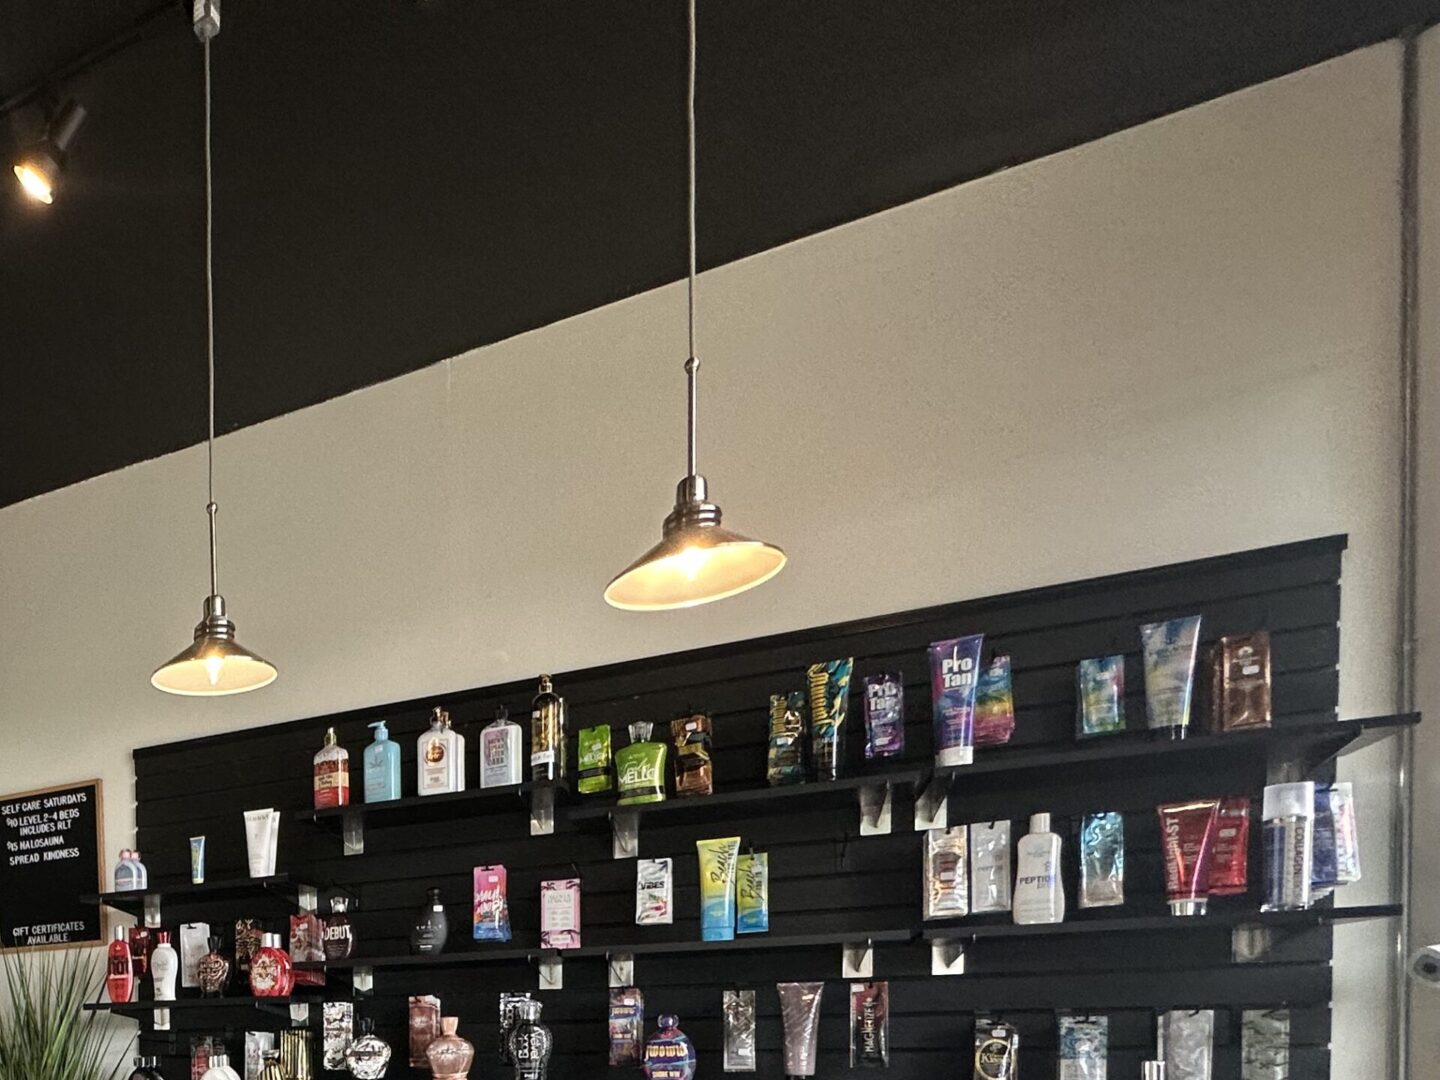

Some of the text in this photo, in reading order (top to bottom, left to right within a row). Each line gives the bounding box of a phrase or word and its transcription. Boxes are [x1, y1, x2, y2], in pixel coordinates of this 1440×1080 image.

[942, 657, 973, 674] Pro
[942, 672, 973, 688] Tan
[868, 682, 897, 698] Pro
[2, 793, 87, 815] SELF CARE SATURDAYS
[20, 815, 42, 826] LEVEL
[44, 812, 57, 822] 2-4
[60, 808, 80, 819] BEDS
[20, 820, 71, 835] INCLUDES RLT
[20, 836, 64, 849] HALOSAUNA
[10, 848, 79, 866] SPREAD KINDNESS
[13, 921, 85, 937] GIFT CERTIFICATES
[324, 924, 351, 940] DEBUT
[27, 933, 68, 944] AVAILABLE
